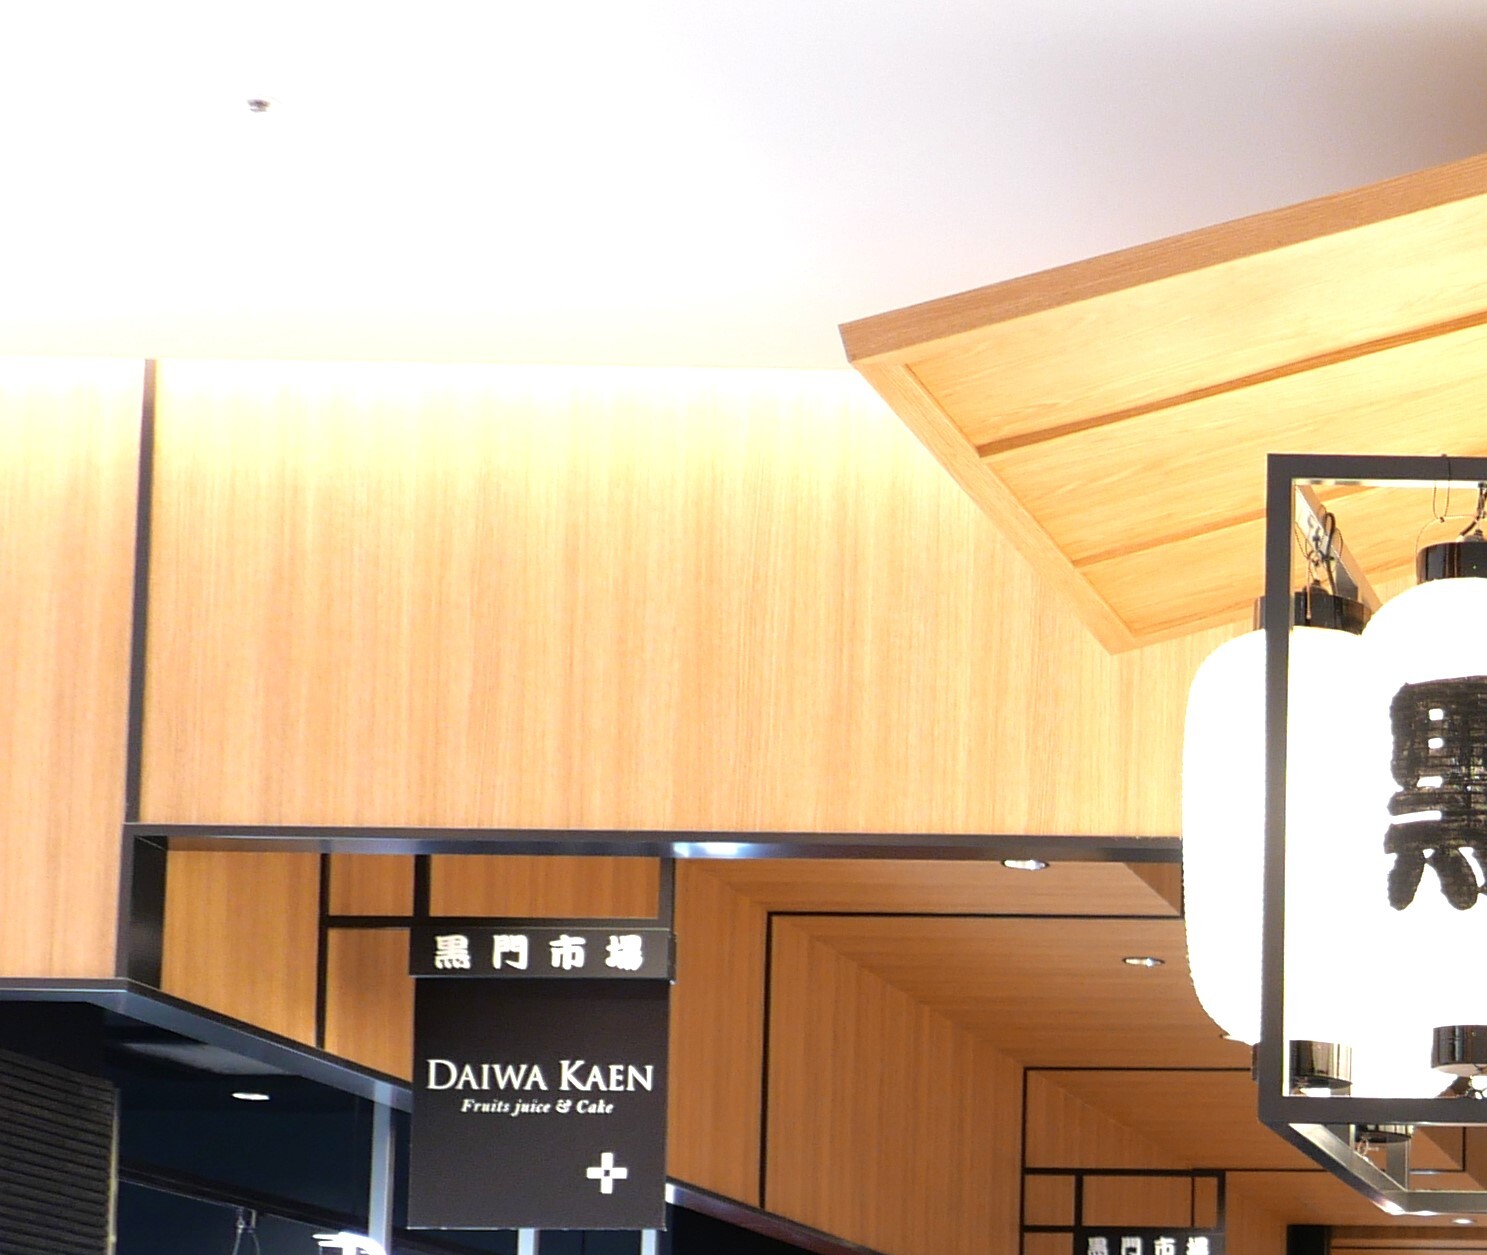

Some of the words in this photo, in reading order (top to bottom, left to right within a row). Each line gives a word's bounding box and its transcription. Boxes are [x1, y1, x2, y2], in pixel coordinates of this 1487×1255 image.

[433, 934, 643, 971] 黒門市場
[426, 1059, 548, 1092] DAIWA
[558, 1060, 654, 1092] KAEN
[460, 1098, 510, 1113] Fruits
[510, 1098, 551, 1117] juice
[555, 1098, 573, 1114] &
